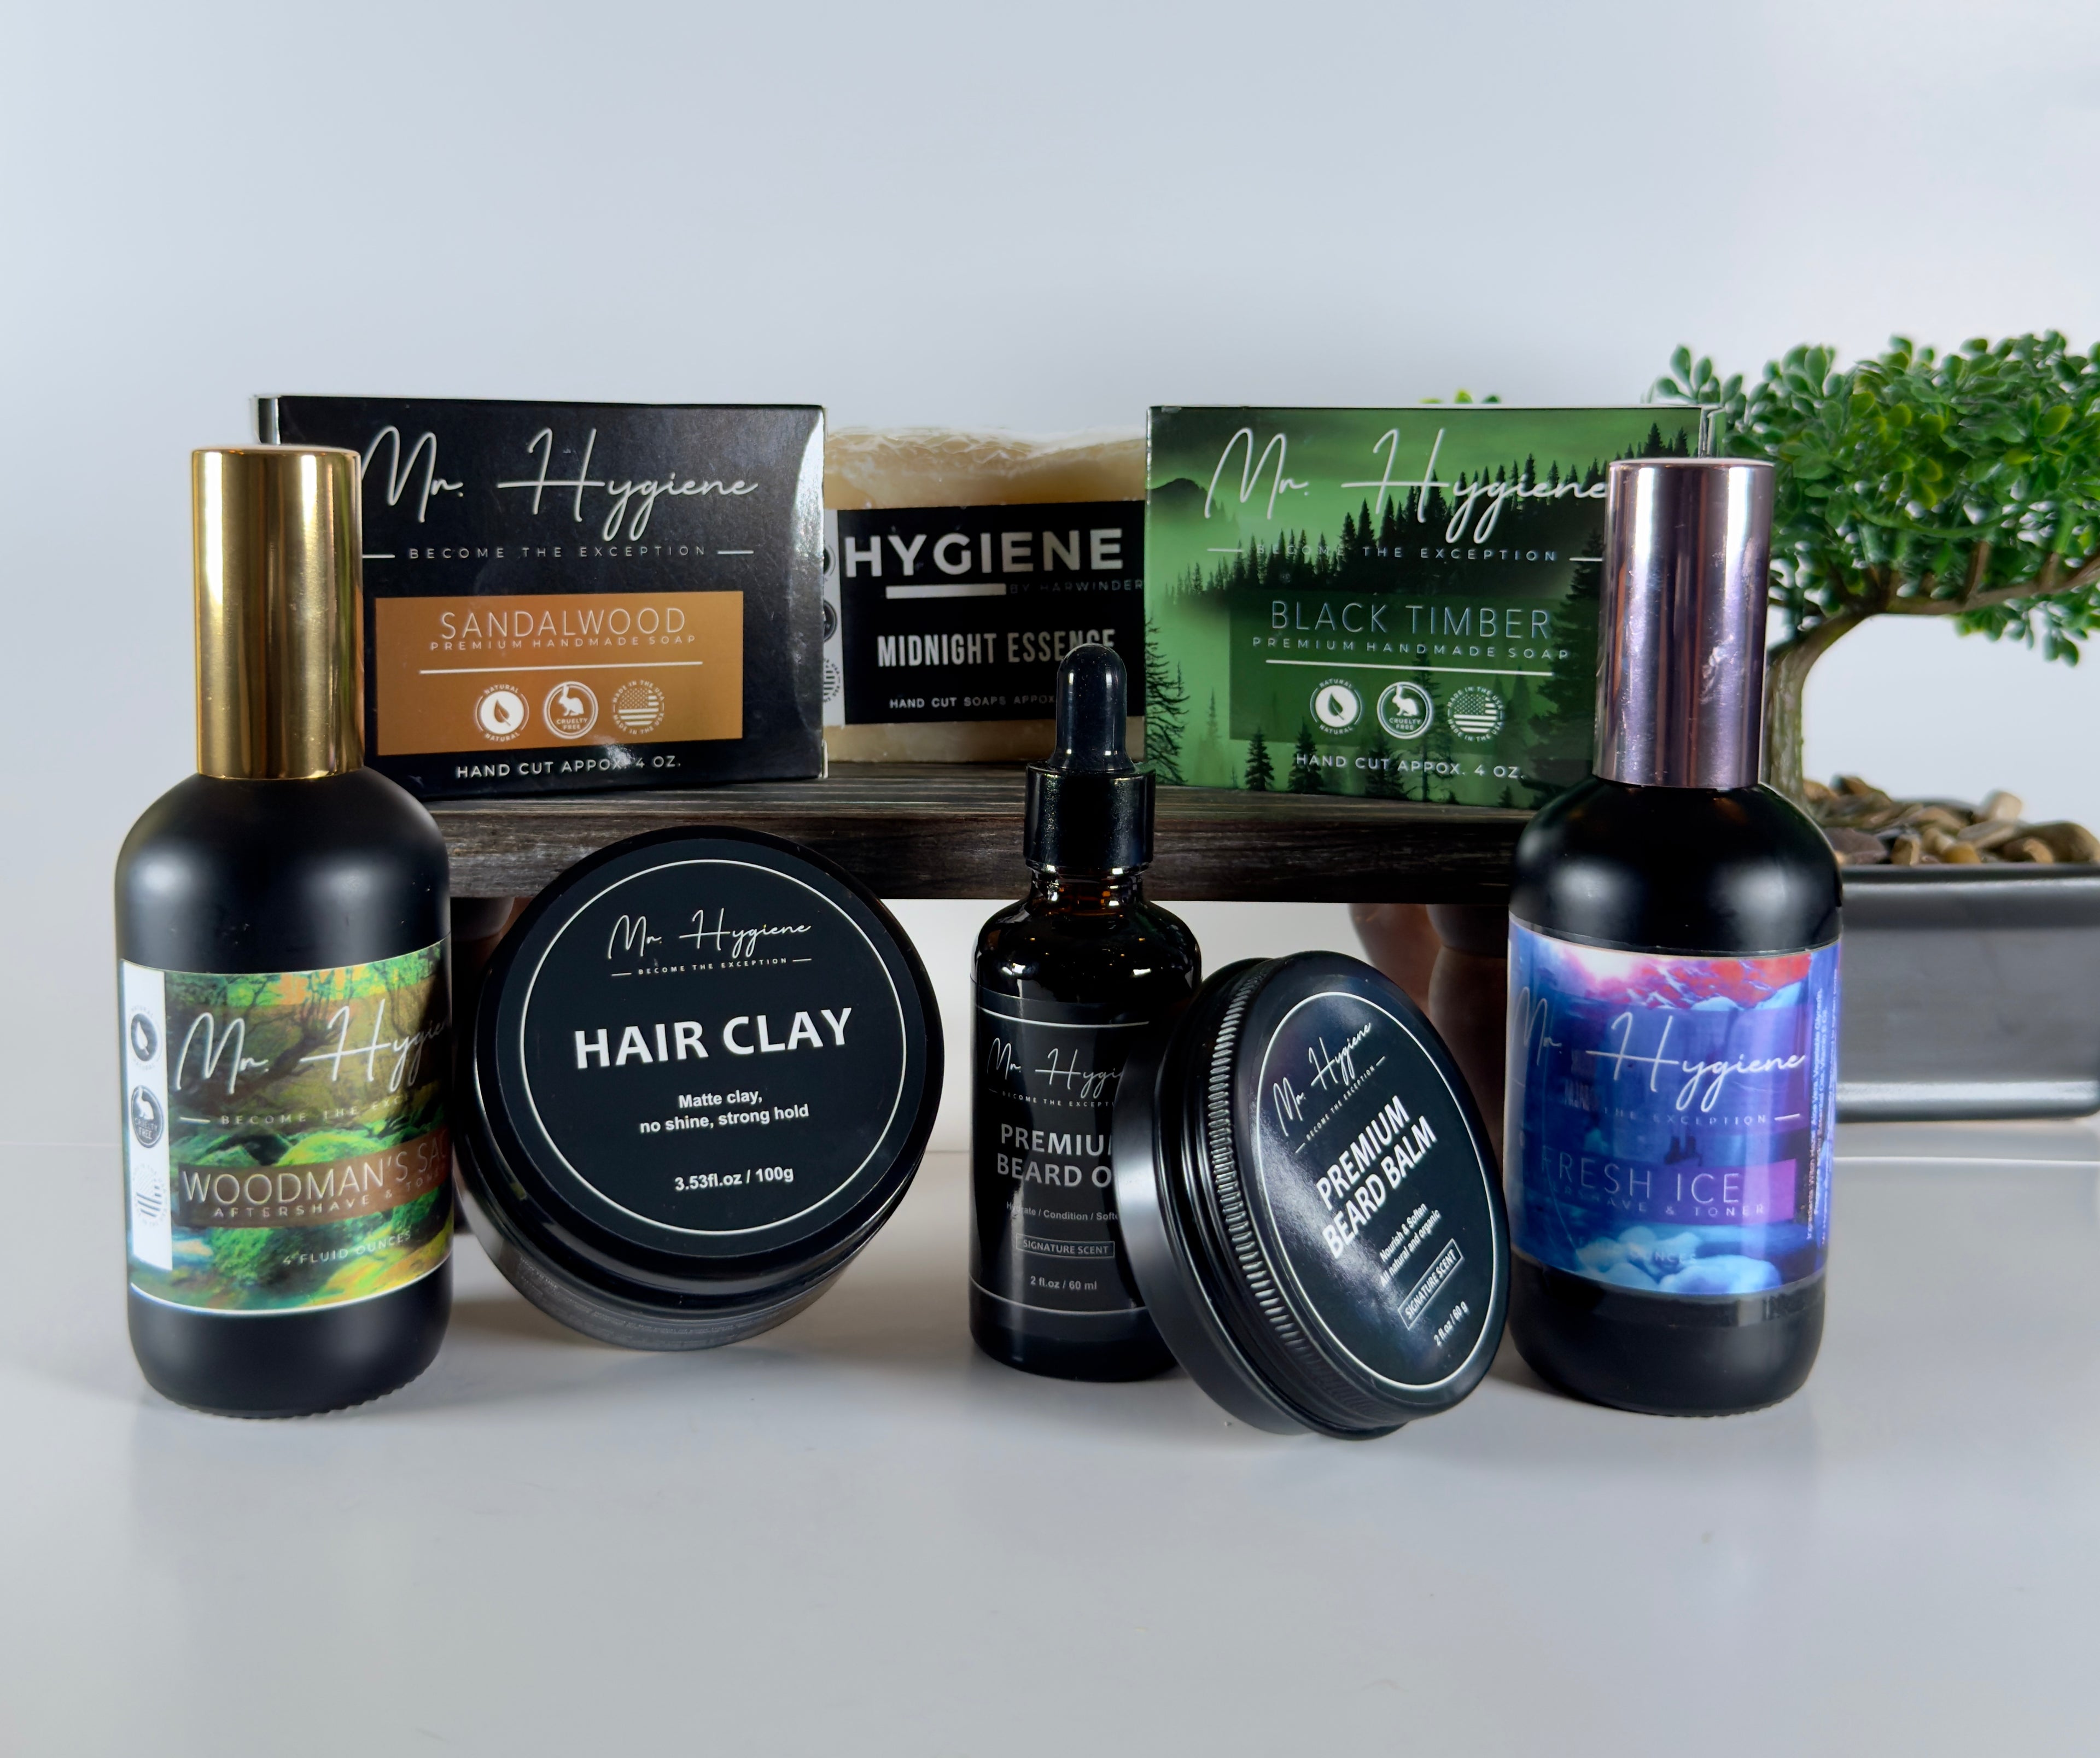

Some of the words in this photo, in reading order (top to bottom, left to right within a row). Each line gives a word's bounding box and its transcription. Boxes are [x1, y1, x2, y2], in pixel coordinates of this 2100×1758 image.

[497, 428, 759, 541] Hygiene
[1204, 427, 1309, 520] Mr.
[1340, 428, 1608, 544] Hygiene
[409, 547, 505, 560] BECOME
[522, 547, 562, 558] THE
[580, 546, 706, 558] EXCEPTION
[845, 528, 1123, 577] HYGIENE
[1257, 545, 1345, 558] BECOME
[1362, 547, 1403, 559] THE
[1420, 548, 1558, 562] EXCEPTION
[1040, 579, 1142, 592] HARWINDER
[440, 607, 686, 640] SANDALWOOD
[1271, 600, 1387, 634] BLACK
[1405, 605, 1552, 639] TIMBER
[430, 639, 522, 651] PREMIUM
[533, 636, 640, 648] HANDMADE
[649, 634, 696, 645] SOAP
[877, 632, 997, 667] MIDNIGHT
[1253, 637, 1355, 651] PREMIUM
[1367, 642, 1496, 658] HANDMADE
[1508, 647, 1571, 659] SOAP
[484, 684, 519, 694] NATURAL
[1319, 679, 1353, 688] NATURAL
[889, 697, 925, 709] HAND
[931, 697, 956, 708] CUT
[964, 696, 1006, 706] SOAPS
[485, 732, 520, 742] NATURAL
[1319, 724, 1354, 735] NATURAL
[457, 763, 510, 779] HAND
[519, 761, 553, 776] CUT
[561, 758, 628, 773] APPOX.
[634, 757, 646, 769] 4
[654, 755, 681, 768] OZ.
[1297, 754, 1348, 767] HAND
[1355, 757, 1389, 770] CUT
[1397, 760, 1467, 776] APPOX.
[1474, 765, 1485, 776] 4
[1493, 766, 1524, 780] OZ.
[608, 915, 662, 959] Mr.
[679, 908, 812, 959] Hygiene
[638, 965, 686, 975] BECOME
[721, 957, 788, 968] EXCEPTION
[176, 1012, 269, 1094] Mr.
[575, 1020, 709, 1070] HAIR
[723, 1008, 852, 1055] CLAY
[1309, 1023, 1372, 1090] Hygiene
[1586, 1011, 1806, 1112] Hygiene
[678, 1094, 722, 1108] Matte
[727, 1090, 763, 1104] clay,
[1003, 1090, 1037, 1103] BECOME
[1306, 1114, 1330, 1141] BECOME
[1330, 1100, 1343, 1114] THE
[1343, 1065, 1375, 1101] EXCEPTION
[221, 1113, 306, 1125] BECOME
[323, 1105, 358, 1120] THE
[640, 1120, 661, 1134] no
[665, 1115, 714, 1131] shine,
[718, 1109, 770, 1126] strong
[774, 1103, 809, 1120] hold
[1653, 1113, 1766, 1126] EXCEPTION
[1001, 1123, 1112, 1156] PREMIU
[1316, 1095, 1411, 1211] PREMIUM
[182, 1151, 408, 1205] WOODMAN'S
[674, 1173, 743, 1192] 3.53fl.oz
[745, 1170, 751, 1184] /
[755, 1166, 794, 1183] 100g
[997, 1153, 1082, 1187] BEARD
[1541, 1146, 1650, 1199] FRESH
[1677, 1172, 1740, 1204] ICE
[1322, 1173, 1387, 1259] BEARD
[1381, 1115, 1439, 1189] BALM
[214, 1194, 370, 1218] AFTERSHAVE
[384, 1189, 393, 1199] &
[1043, 1210, 1088, 1221] Condition
[1665, 1205, 1676, 1216] &
[1696, 1203, 1764, 1217] TONER
[282, 1255, 293, 1265] 4
[300, 1248, 348, 1264] FLUID
[356, 1230, 412, 1255] OUNCES
[1023, 1239, 1075, 1254] SIGNATURE
[1078, 1246, 1109, 1254] SCENT
[1379, 1231, 1405, 1263] Nourish
[1401, 1223, 1410, 1236] &
[1407, 1203, 1428, 1229] Soften
[1380, 1270, 1391, 1287] All
[1389, 1245, 1411, 1277] natural
[1408, 1232, 1421, 1253] and
[1419, 1210, 1442, 1240] organic
[1030, 1275, 1036, 1285] 2
[1039, 1277, 1060, 1289] fl.oz
[1069, 1281, 1081, 1290] 60
[1084, 1281, 1097, 1290] ml
[1405, 1272, 1439, 1319] SIGNATURE
[1436, 1249, 1457, 1280] SCENT
[1434, 1334, 1442, 1347] 2
[1452, 1305, 1463, 1322] 60
[1461, 1300, 1469, 1315] g
